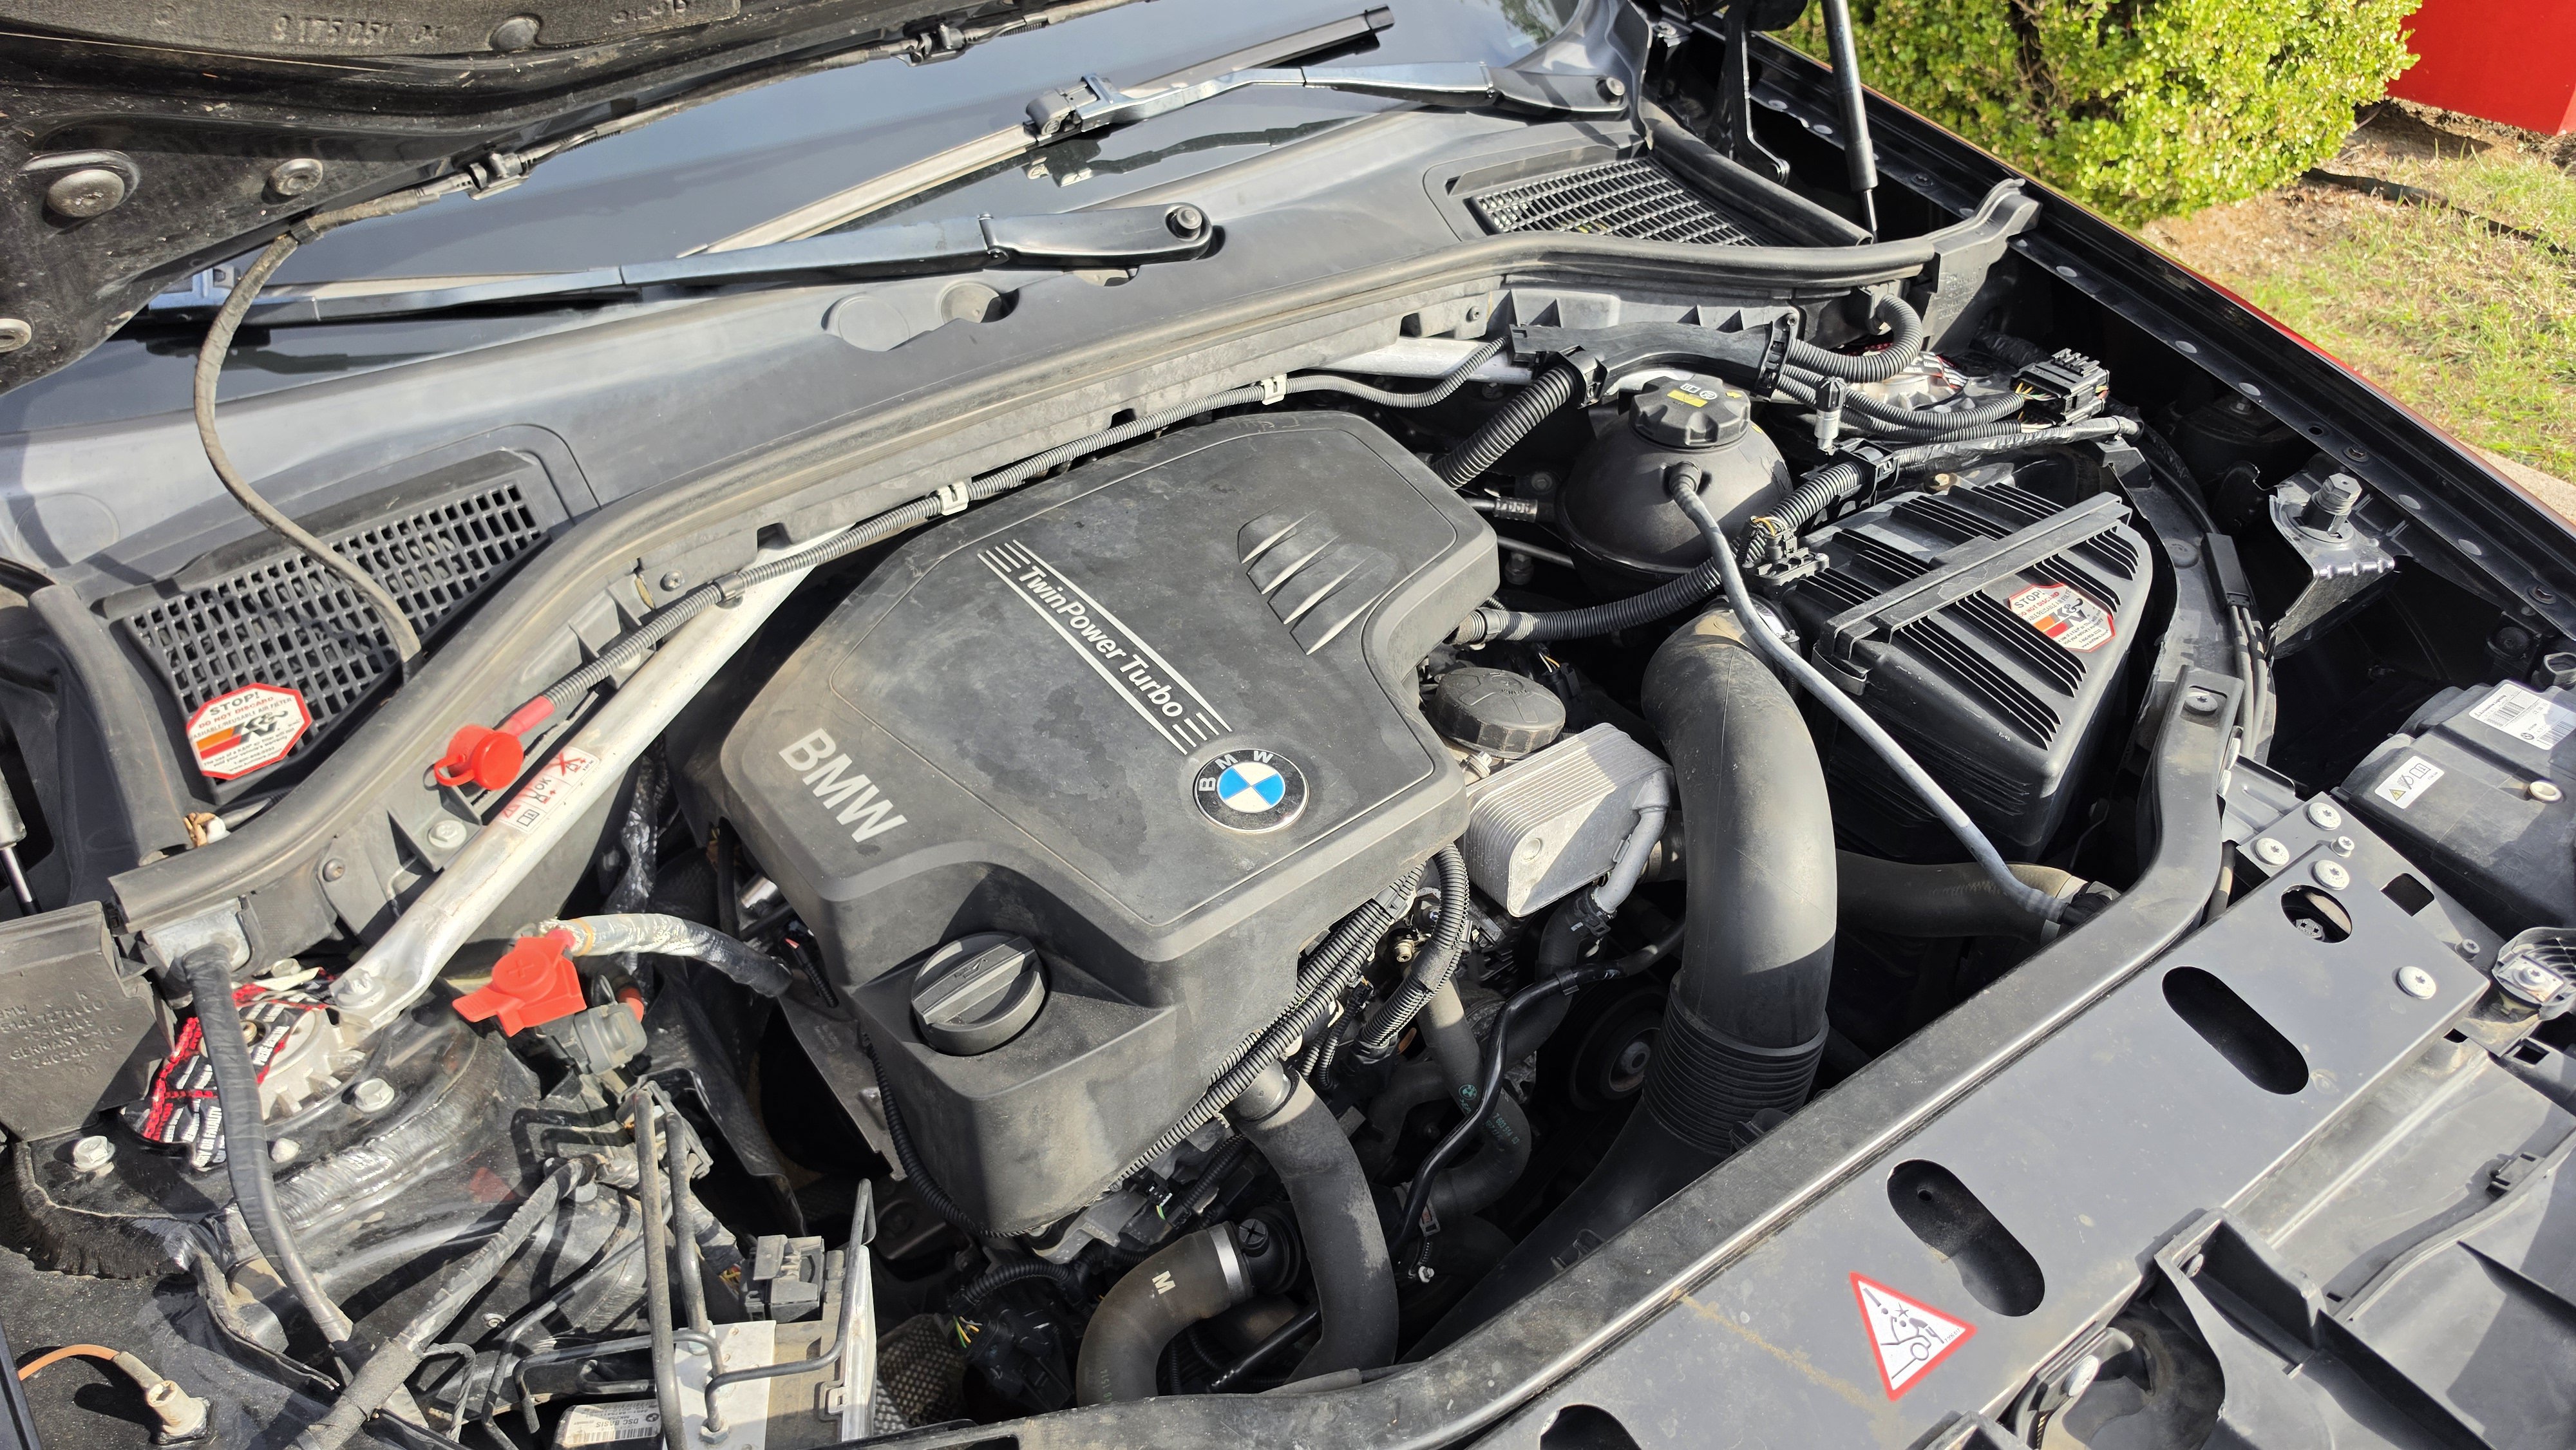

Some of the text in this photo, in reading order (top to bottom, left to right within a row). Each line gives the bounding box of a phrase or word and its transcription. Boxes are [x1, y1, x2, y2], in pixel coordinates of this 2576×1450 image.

[2014, 590, 2045, 608] STOP!
[2027, 605, 2038, 613] NOT
[2039, 592, 2060, 607] DISCARD
[2061, 587, 2072, 603] FILTE
[1016, 564, 1184, 717] TwinPower Turbo
[191, 697, 292, 739] ASHABLE/REUSABLE AIR FILTER
[198, 697, 274, 729] DO NOT DISCARD
[209, 692, 260, 716] STOP!
[233, 710, 289, 744] K&N
[535, 778, 552, 791] OK
[778, 728, 907, 842] BMW
[1198, 749, 1275, 793] BMW
[202, 1106, 222, 1138] FATALITY
[1152, 1270, 1176, 1294] M
[596, 1419, 620, 1427] BASIS
